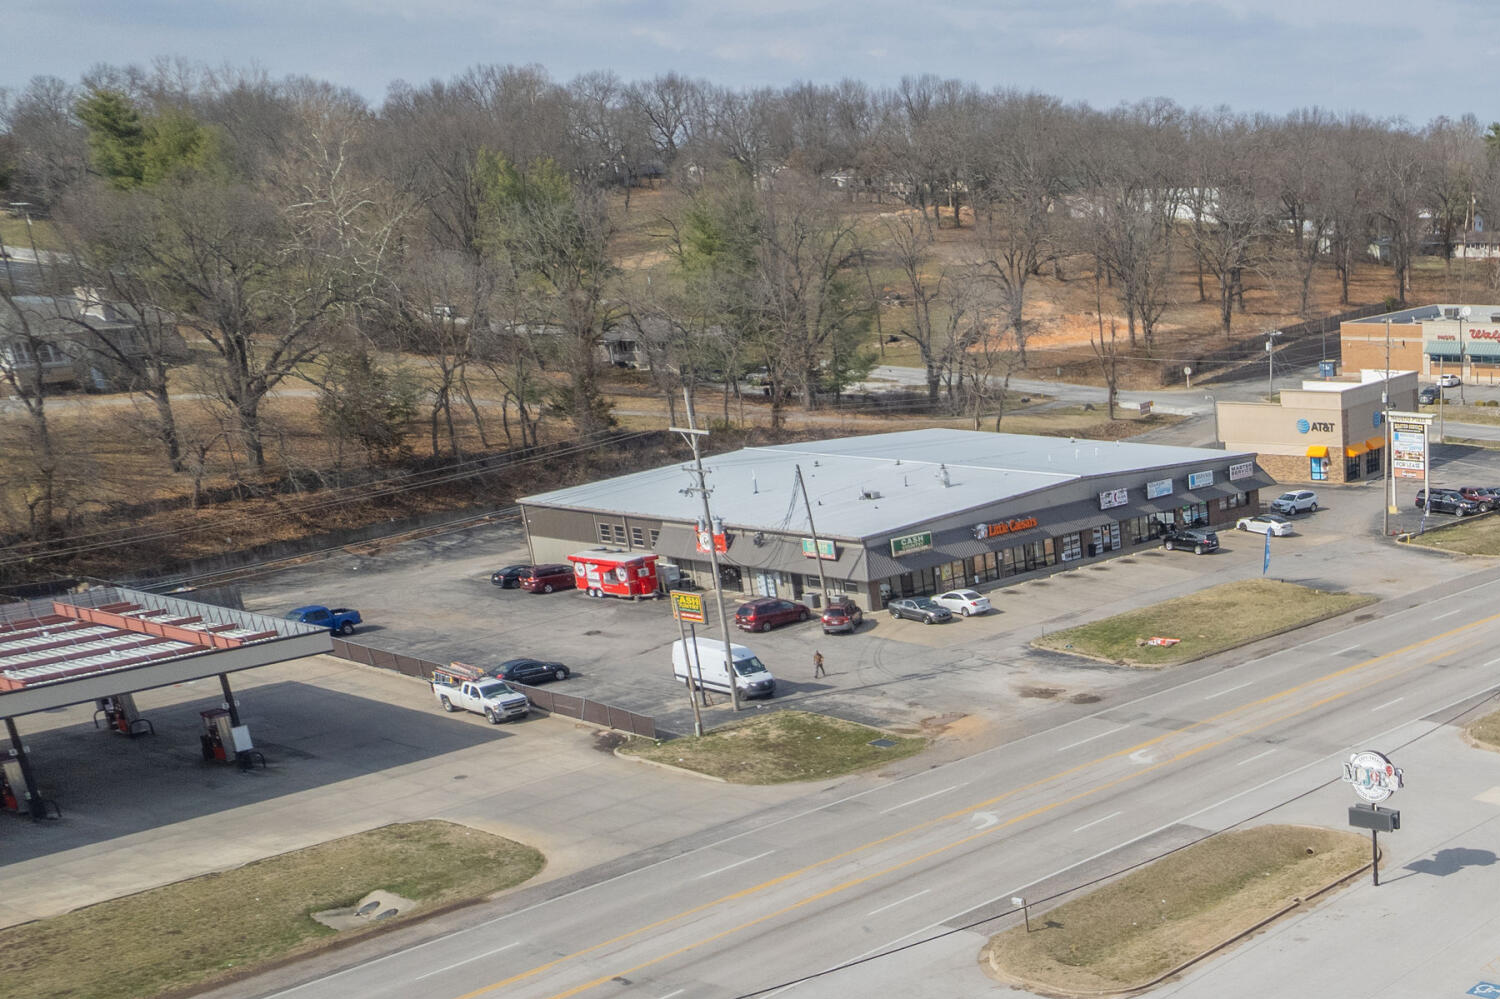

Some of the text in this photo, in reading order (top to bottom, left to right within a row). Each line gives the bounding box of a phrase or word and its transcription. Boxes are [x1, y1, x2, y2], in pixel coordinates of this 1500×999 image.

[1311, 422, 1335, 432] AT&T
[989, 522, 1008, 536] Little
[901, 535, 924, 546] CASH
